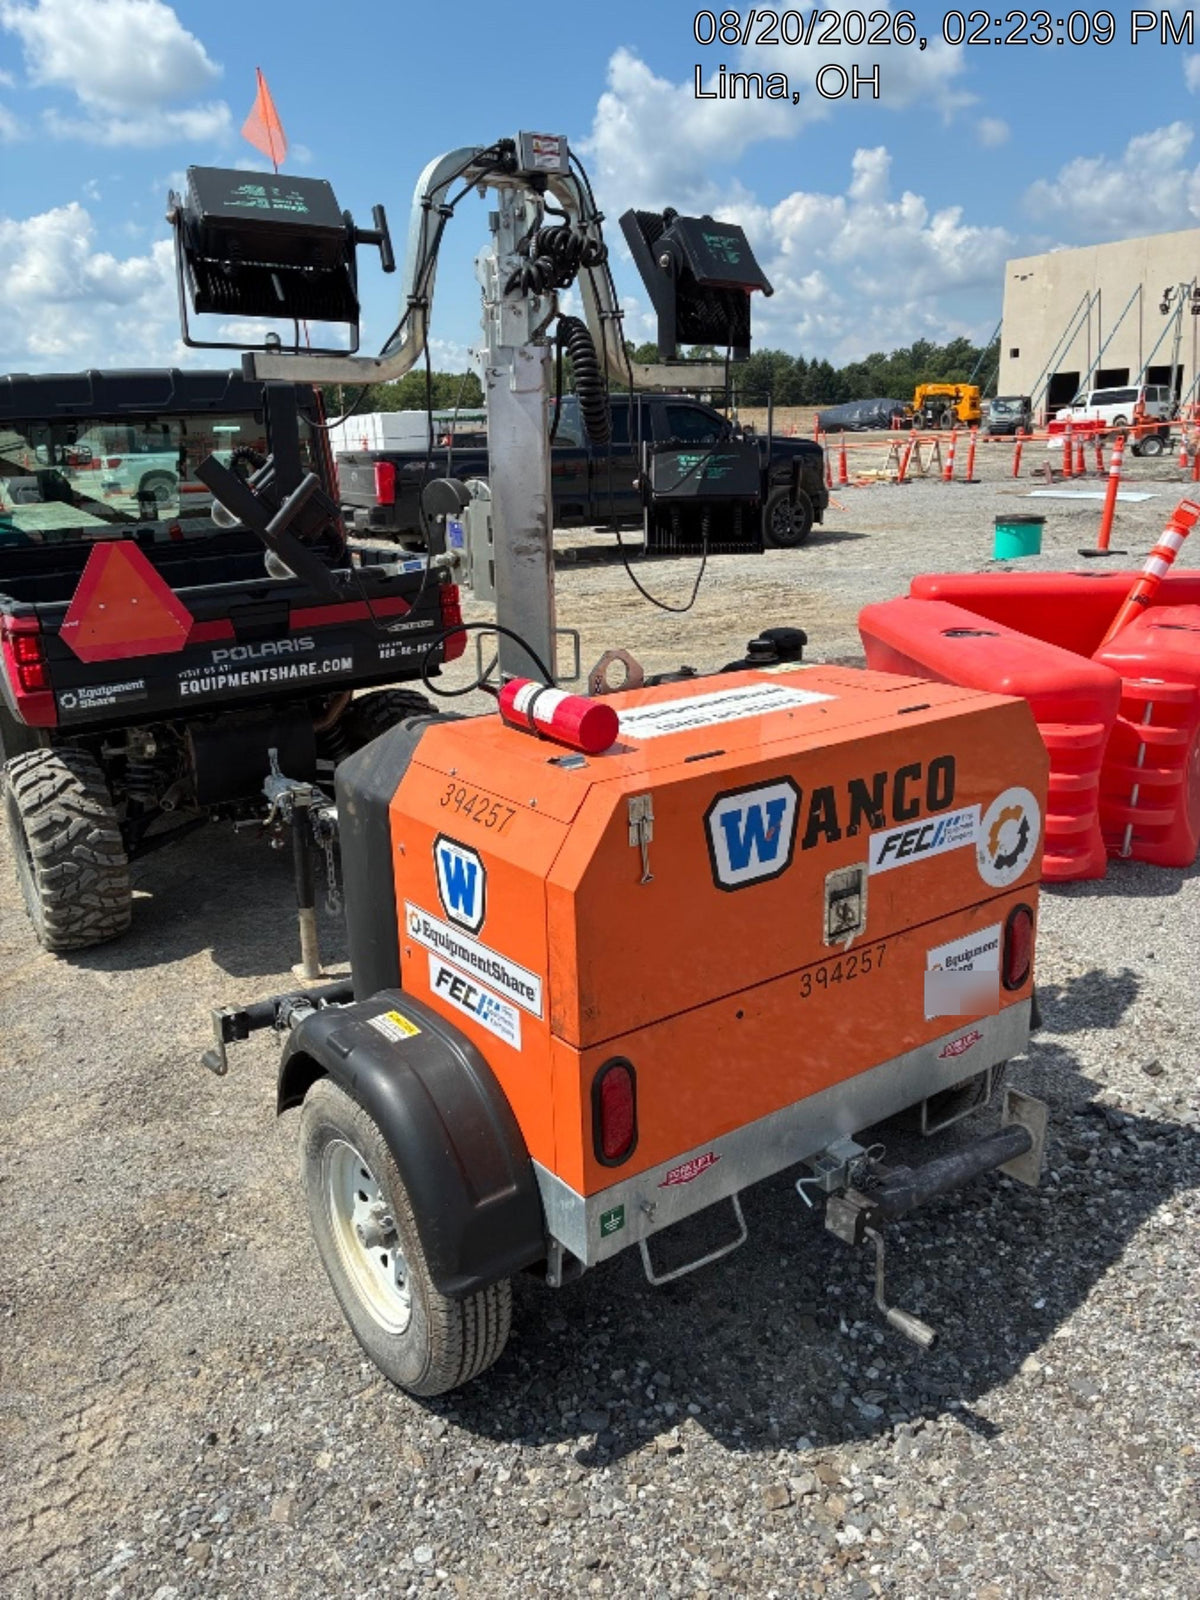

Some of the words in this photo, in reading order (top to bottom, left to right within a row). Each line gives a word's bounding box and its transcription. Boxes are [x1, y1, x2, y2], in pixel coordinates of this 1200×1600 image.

[212, 636, 316, 664] POLARIS
[78, 679, 145, 698] Equipment
[179, 656, 353, 696] EQUIPMENTSHARE.COM
[79, 696, 117, 709] Share
[440, 783, 517, 833] 394257
[720, 754, 956, 872] WANCO
[876, 824, 934, 866] FEC
[440, 847, 477, 918] W
[422, 920, 536, 1001] EquipmentShare
[800, 943, 887, 998] 394257
[945, 938, 999, 967] Equipment
[435, 966, 480, 1013] FEC
